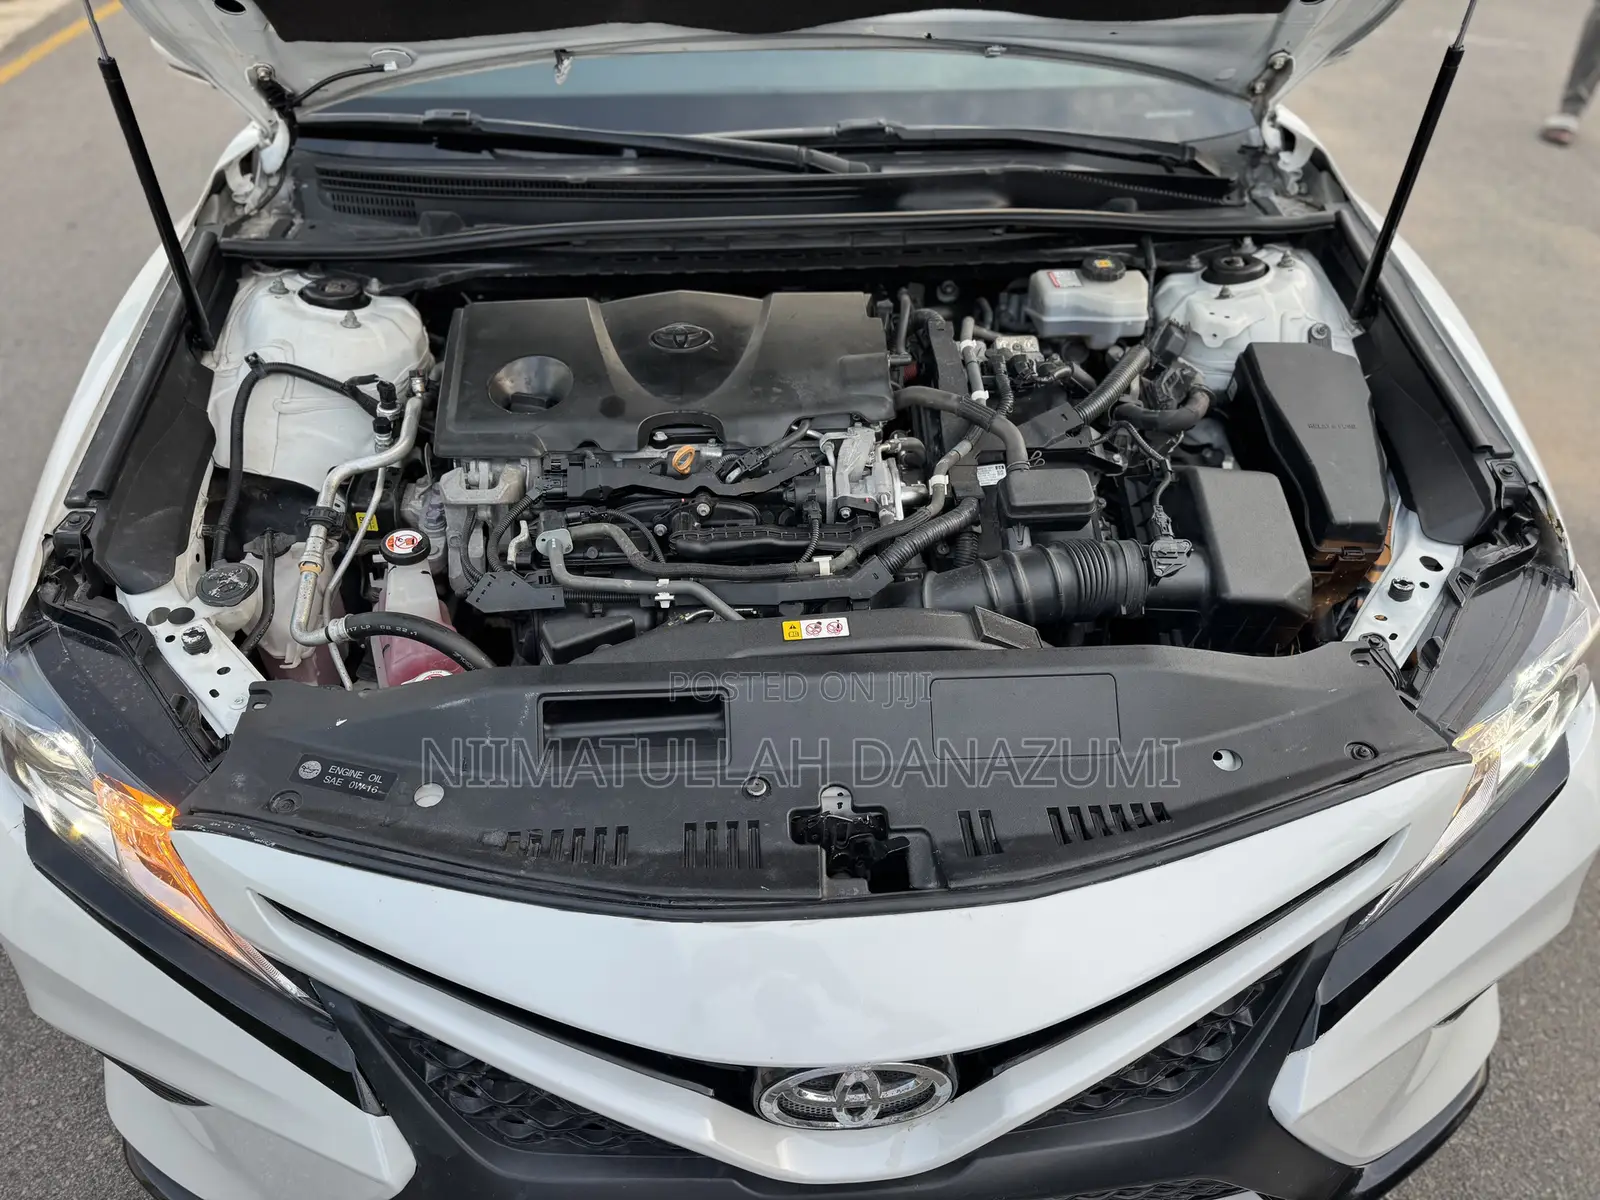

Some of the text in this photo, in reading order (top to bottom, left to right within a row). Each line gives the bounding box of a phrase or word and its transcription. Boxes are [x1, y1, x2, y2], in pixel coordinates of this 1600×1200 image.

[328, 765, 383, 783] ENGINE OIL
[323, 775, 379, 794] SAE 0W-16
